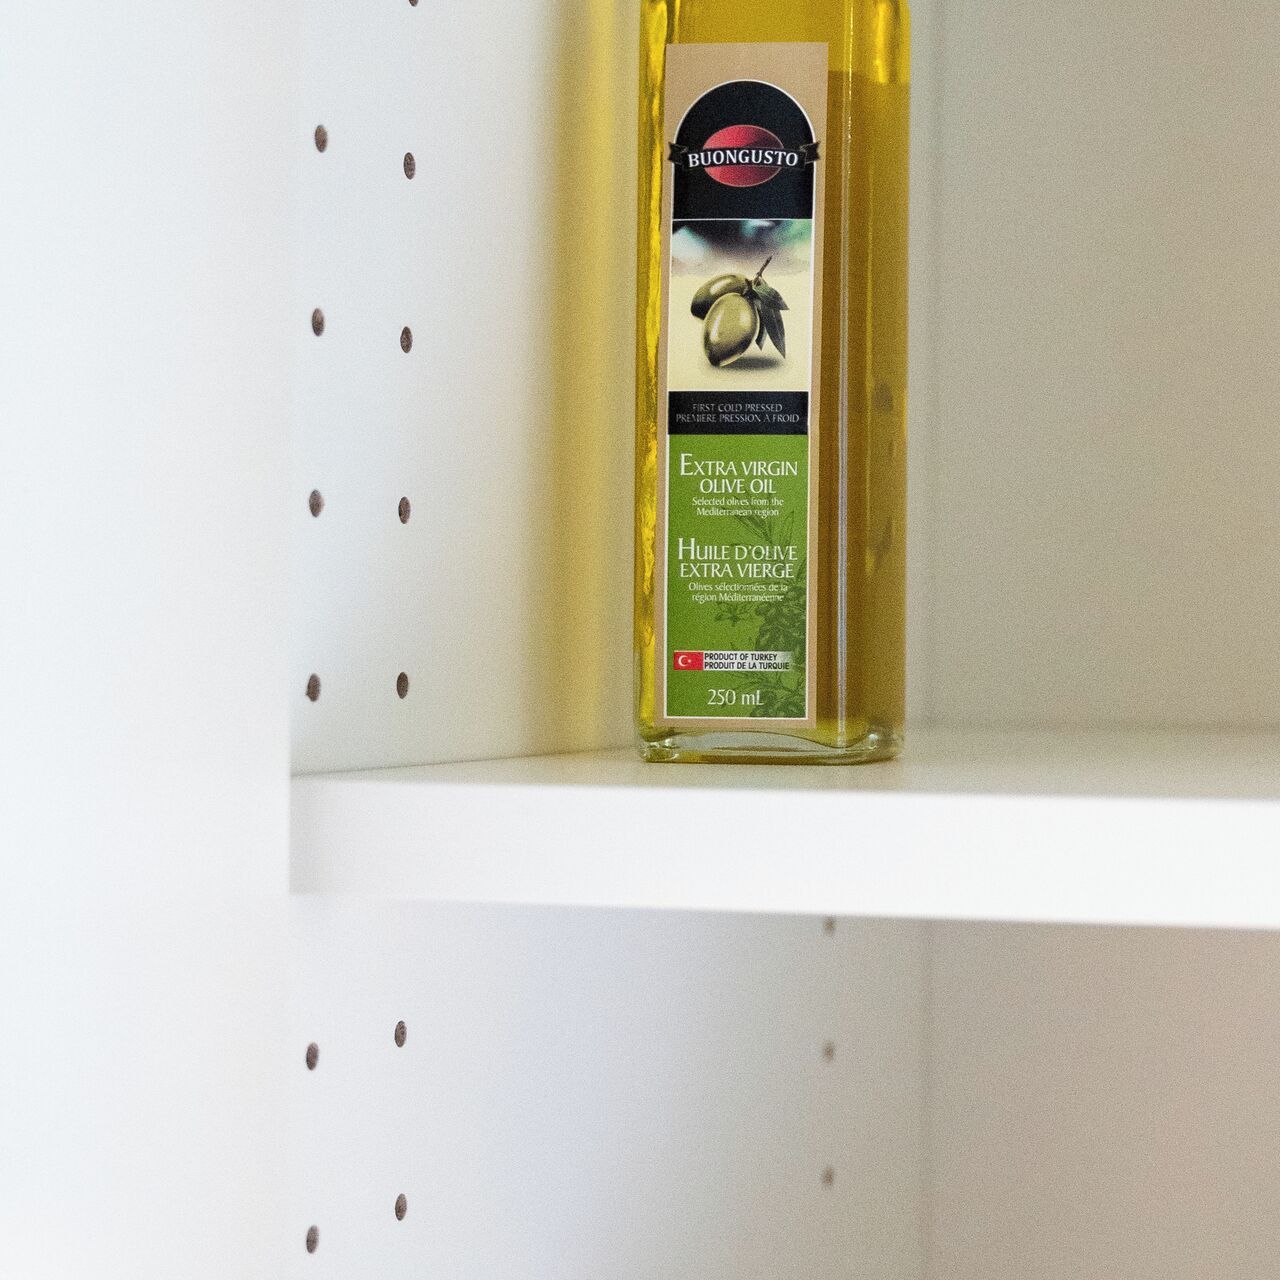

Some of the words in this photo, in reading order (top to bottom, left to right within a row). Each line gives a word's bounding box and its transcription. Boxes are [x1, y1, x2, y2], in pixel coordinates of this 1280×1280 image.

[688, 149, 798, 168] BUONGUSTO
[693, 404, 715, 412] FIRST
[718, 404, 742, 412] COLD
[745, 404, 782, 412] PRESSED
[720, 414, 761, 422] PRESSION
[772, 414, 799, 423] FROID
[680, 453, 738, 476] EXTRA
[741, 461, 798, 476] VIRGIN
[700, 479, 746, 493] OLIVE
[750, 479, 776, 493] OIL
[692, 497, 725, 506] Selected
[751, 497, 769, 506] from
[771, 497, 784, 506] the
[697, 508, 752, 516] Mediterranean
[754, 508, 779, 519] region
[678, 538, 730, 560] HUILE
[735, 545, 798, 560] D'OLIVE
[680, 563, 733, 578] EXTRA
[737, 563, 794, 578] VIERGE
[689, 582, 713, 591] Olives
[769, 583, 778, 591] de
[780, 583, 788, 591] la
[692, 593, 717, 604] région
[759, 662, 789, 670] TURQUIE
[707, 689, 736, 705] 250
[741, 690, 764, 705] mL
